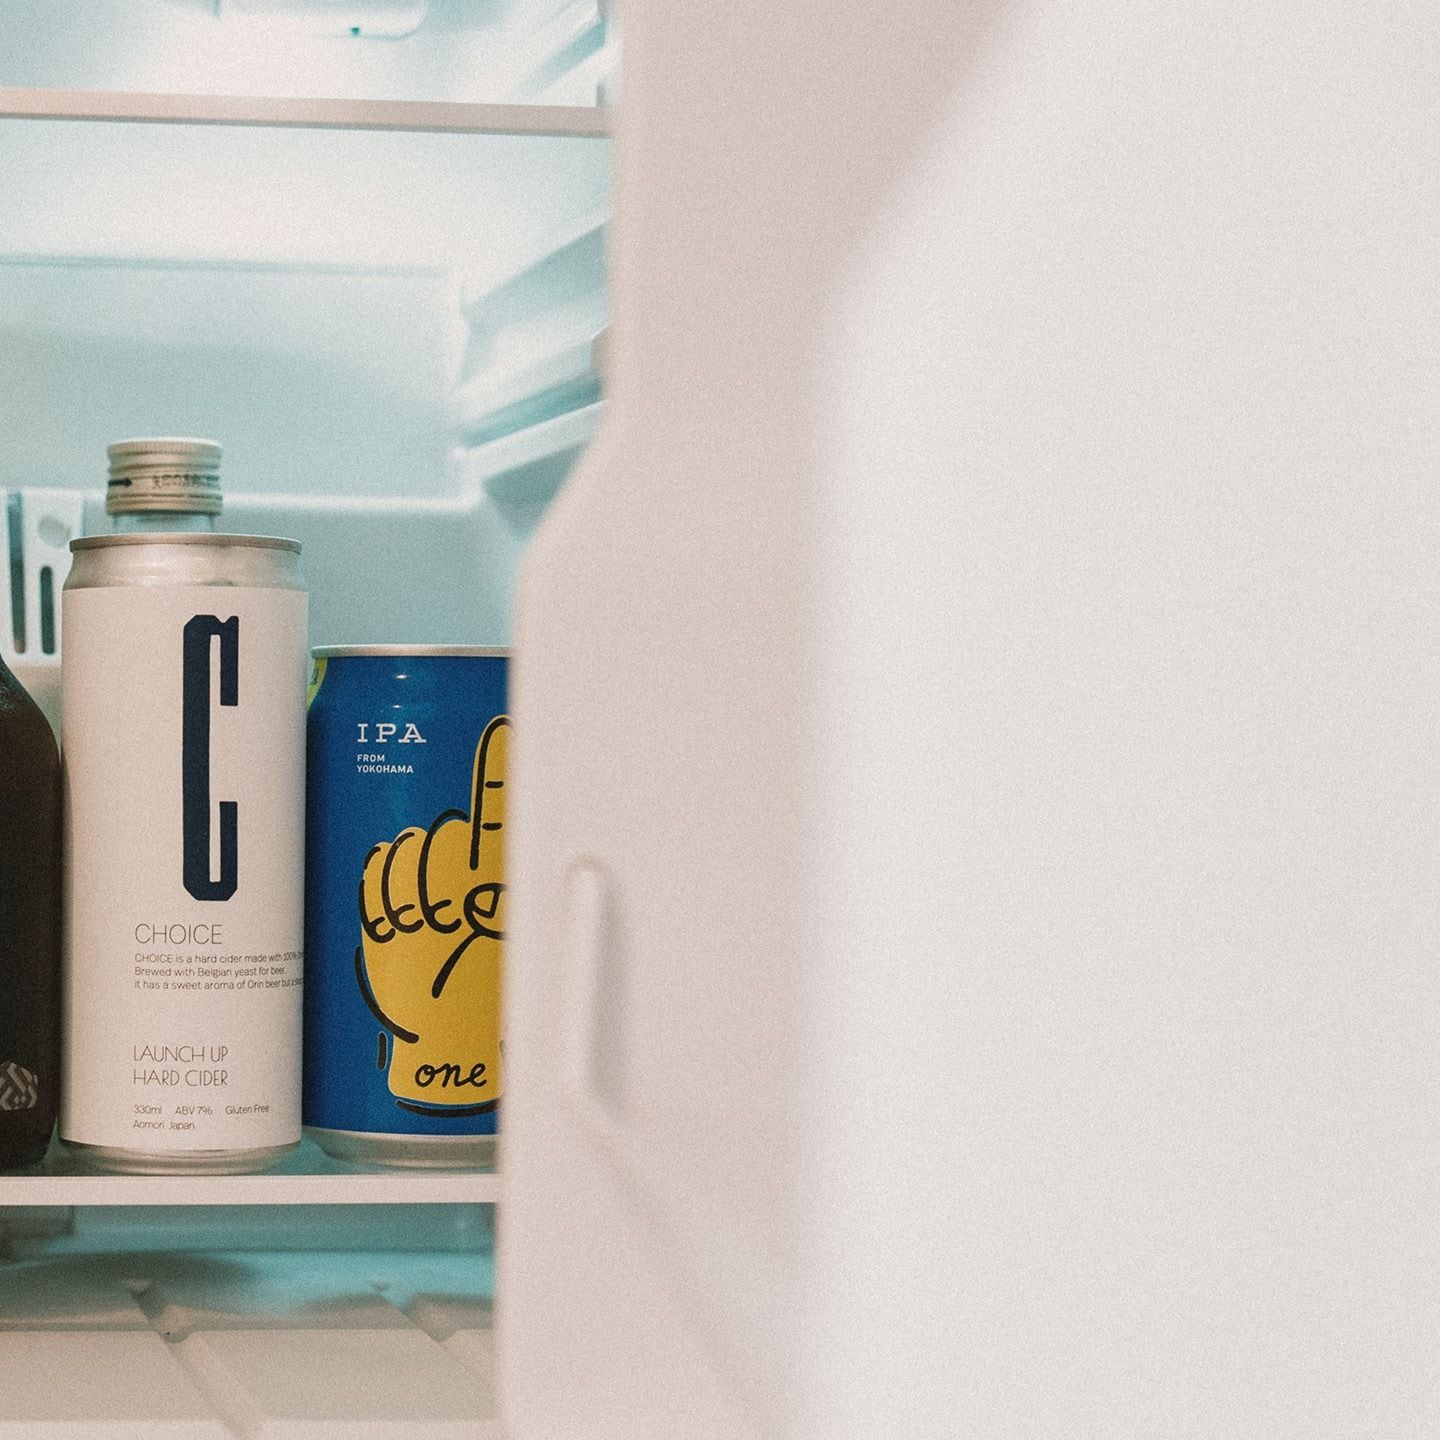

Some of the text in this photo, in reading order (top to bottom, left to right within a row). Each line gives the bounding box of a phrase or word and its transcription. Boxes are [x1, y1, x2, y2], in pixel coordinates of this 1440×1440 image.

[357, 723, 427, 743] IPA
[182, 614, 239, 901] C
[357, 754, 385, 763] FROM
[357, 765, 414, 774] YOKOHAMA
[134, 923, 224, 945] CHOICE
[134, 953, 173, 963] CHOICE
[176, 954, 184, 963] is
[195, 953, 217, 963] hard
[219, 952, 243, 963] cider
[244, 953, 267, 962] made
[134, 967, 172, 976] Brewed
[174, 966, 195, 977] with
[197, 967, 232, 978] Belgian
[234, 967, 257, 977] yeast
[259, 967, 269, 975] for
[143, 980, 161, 988] has
[171, 981, 201, 989] sweet
[236, 980, 246, 989] of
[133, 1046, 229, 1063] LAUNCH UP
[133, 1069, 228, 1087] HARD CIDER
[414, 1063, 488, 1088] one
[133, 1104, 270, 1116] 330ml ABV 7% Gluten Free
[132, 1120, 196, 1130] Aomori Japan
